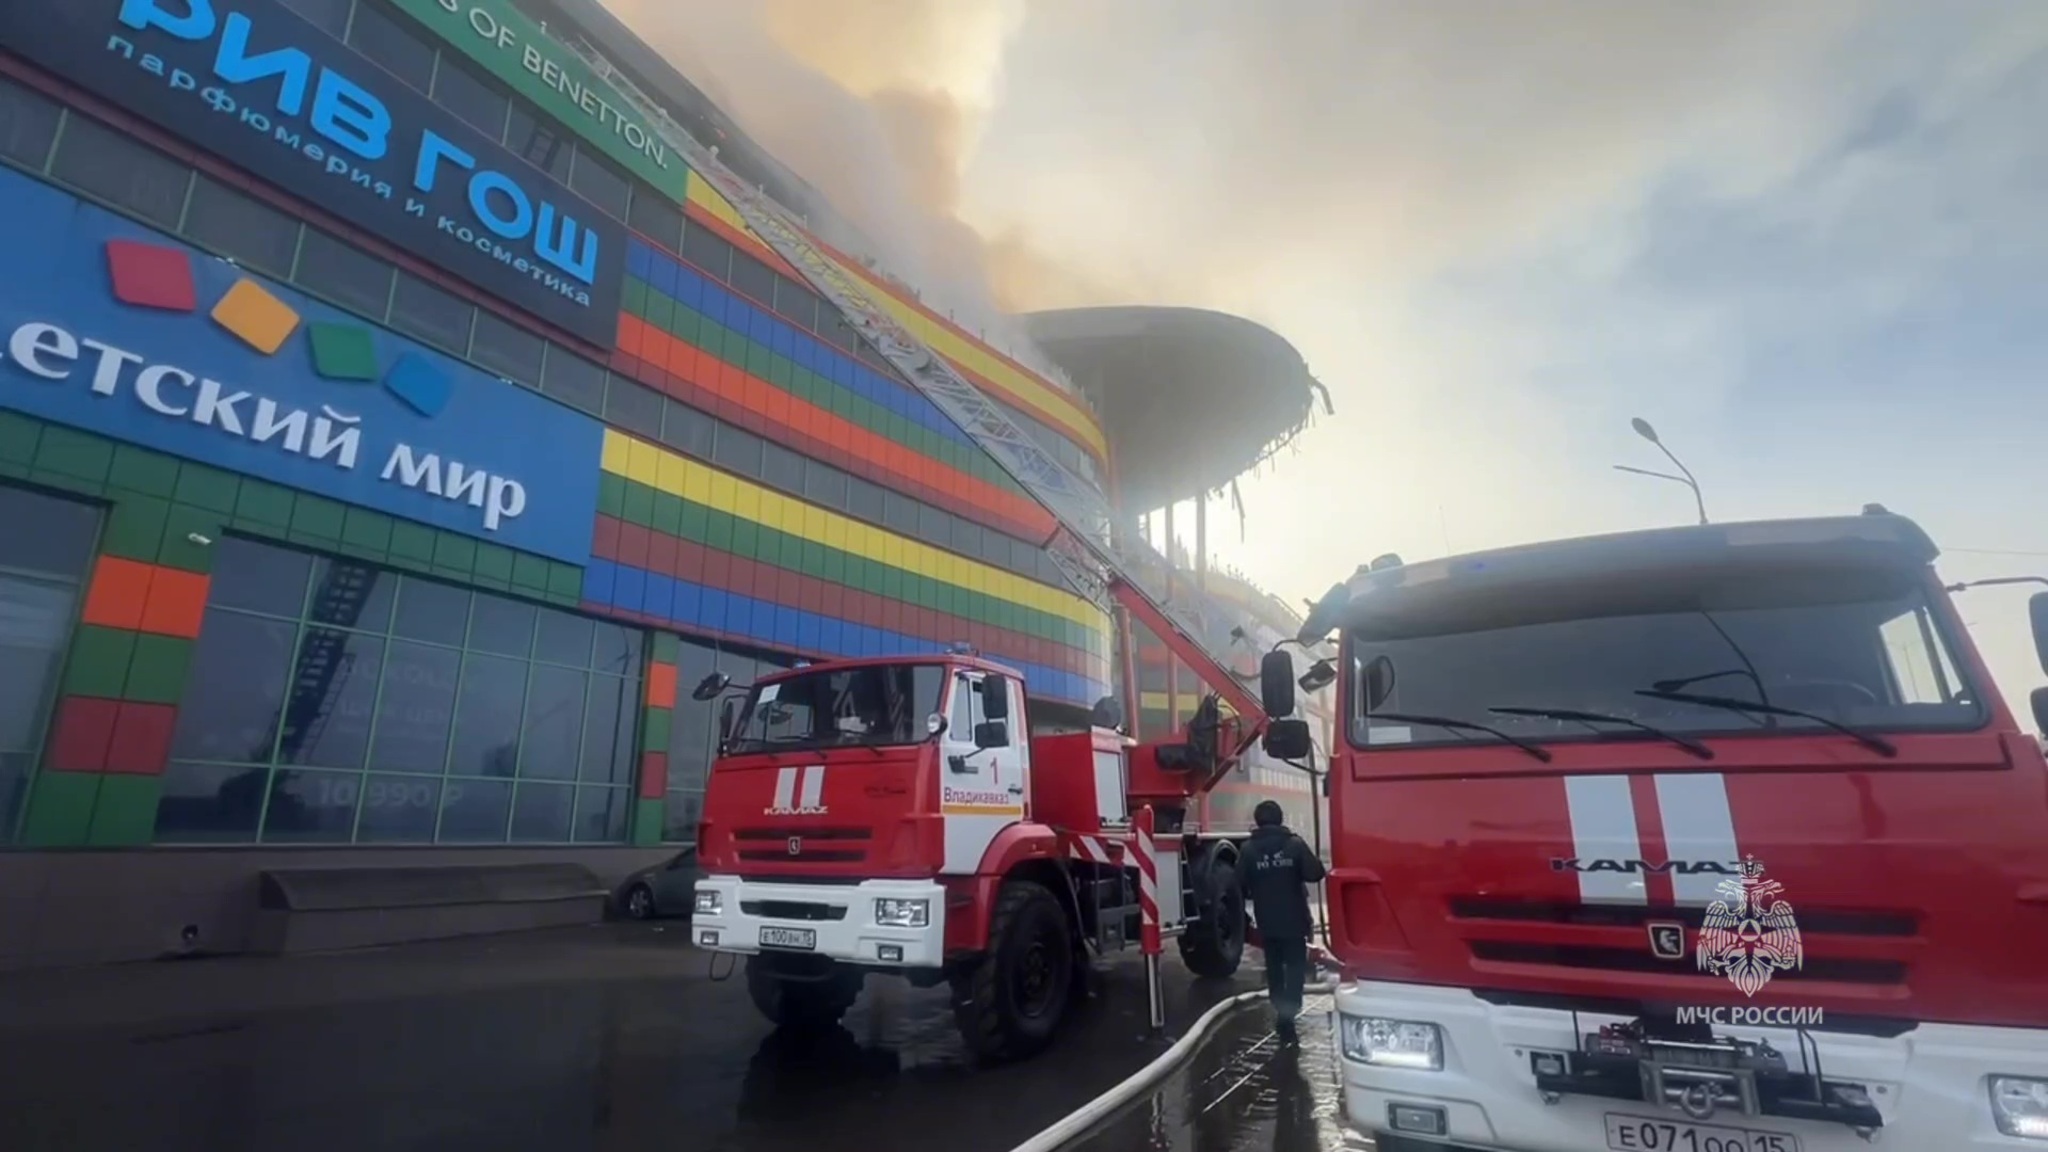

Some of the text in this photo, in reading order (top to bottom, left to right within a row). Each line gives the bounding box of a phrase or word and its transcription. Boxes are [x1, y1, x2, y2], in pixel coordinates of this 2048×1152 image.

[469, 8, 516, 48] OF
[106, 35, 590, 307] парфюмерия и косметика
[414, 128, 598, 285] ГОШ
[0, 320, 526, 532] етский мир
[943, 786, 1009, 805] Владикавказ
[989, 756, 999, 785] 1
